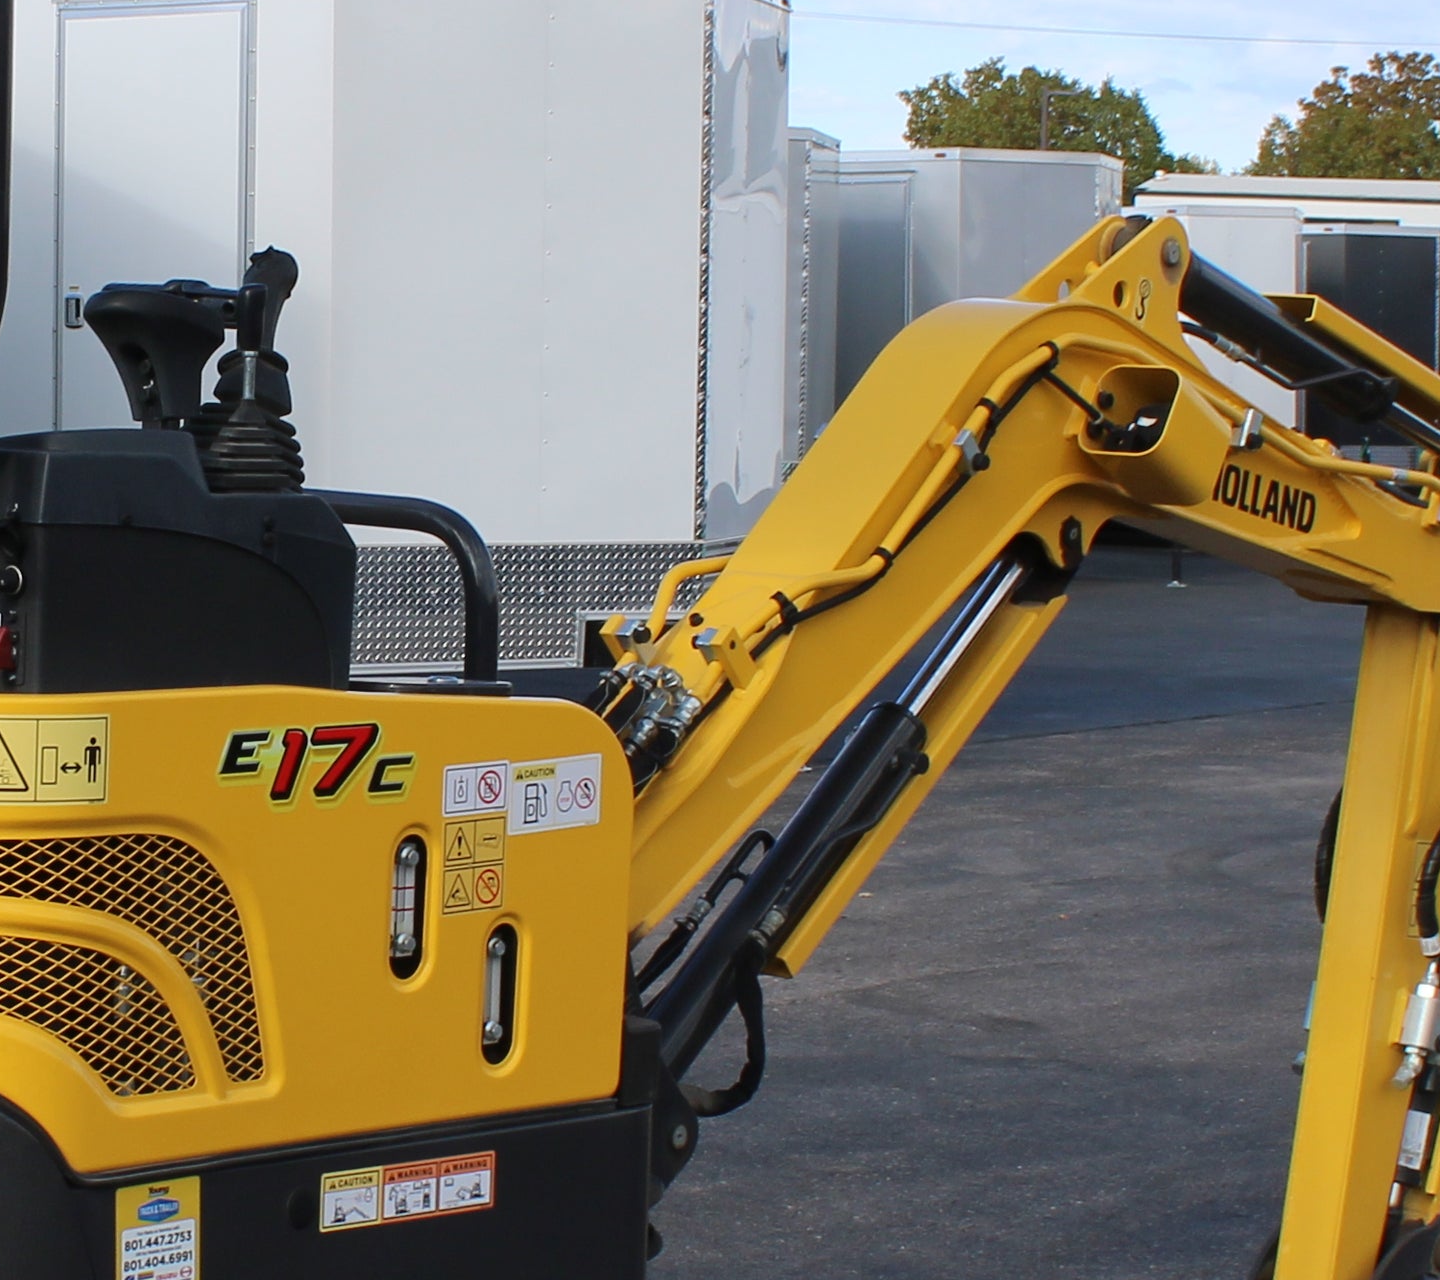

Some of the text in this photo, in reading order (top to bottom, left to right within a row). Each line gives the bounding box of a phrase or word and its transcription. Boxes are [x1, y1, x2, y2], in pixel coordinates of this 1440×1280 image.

[524, 767, 555, 779] CAUTION
[452, 1159, 488, 1171] WARNING
[396, 1167, 434, 1180] WARNING
[337, 1175, 374, 1189] CAUTION
[124, 1230, 192, 1252] 801.447.2753
[123, 1250, 193, 1272] 801.404.6991
